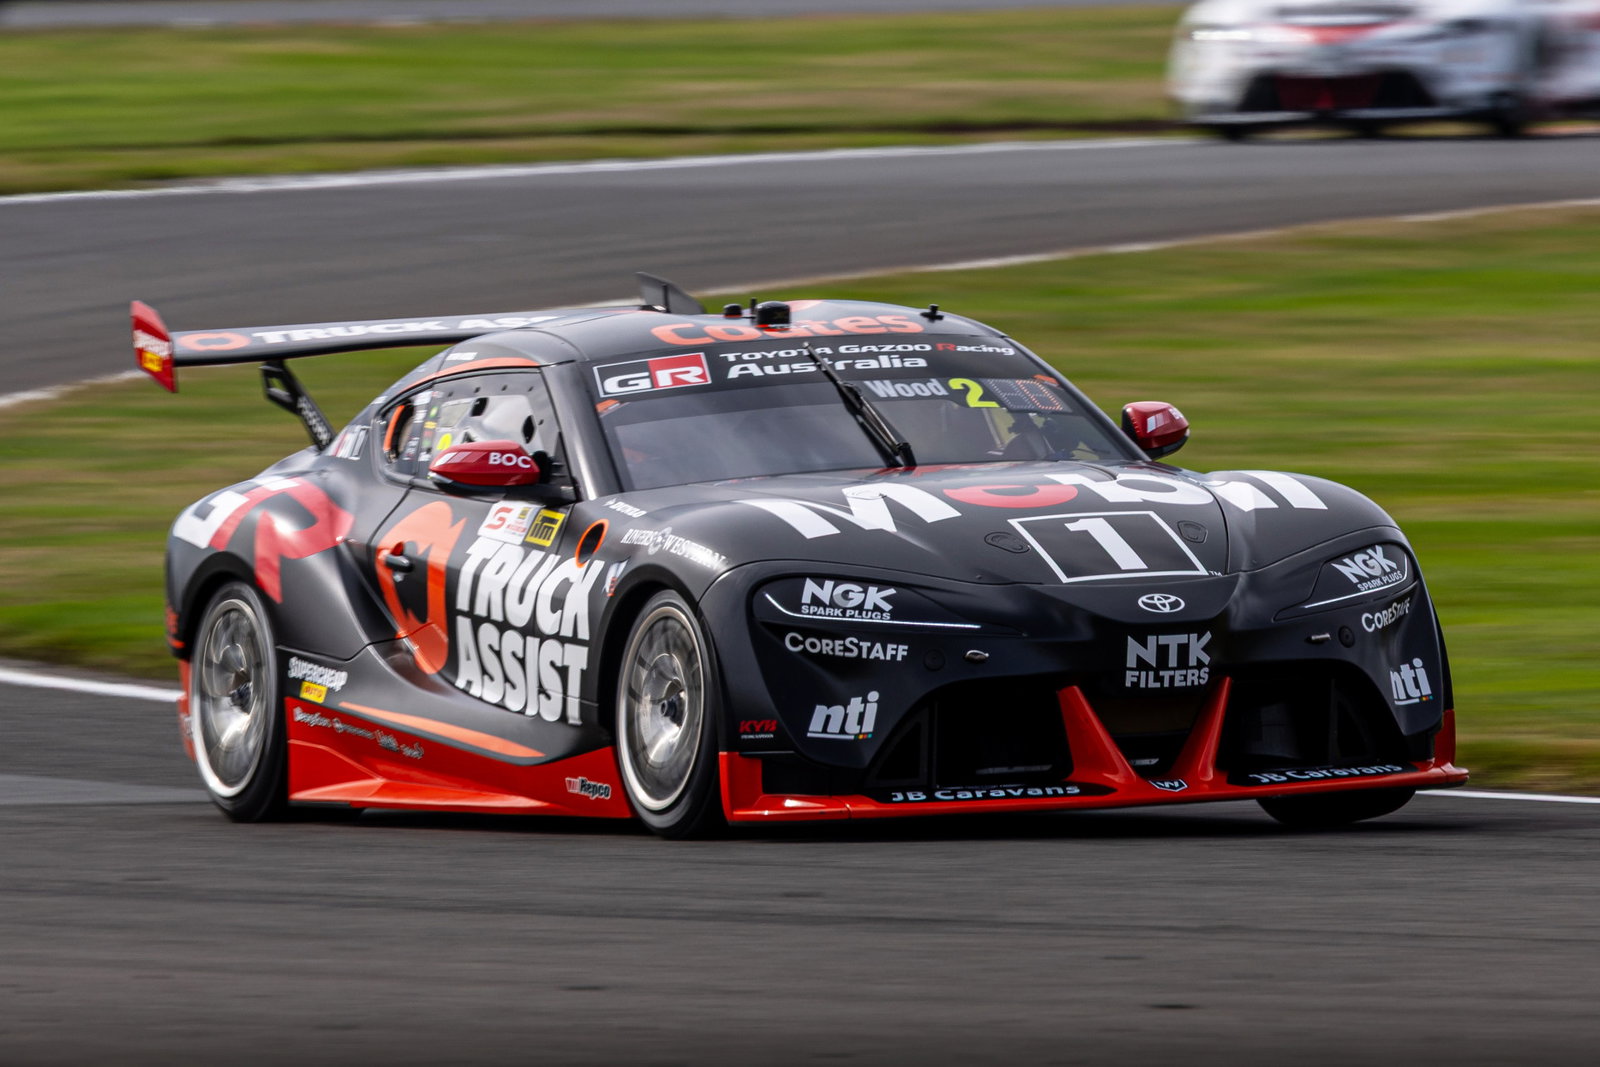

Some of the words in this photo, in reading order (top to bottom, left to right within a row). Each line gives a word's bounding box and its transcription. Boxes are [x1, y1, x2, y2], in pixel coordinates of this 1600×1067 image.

[251, 322, 448, 344] TRUCK
[651, 315, 924, 346] Coates
[720, 346, 834, 362] TOYOTA
[838, 344, 932, 355] GAZOO
[936, 343, 1015, 356] Racing
[727, 355, 928, 379] Australia
[603, 364, 706, 394] GR
[864, 378, 949, 398] Wood
[948, 378, 1000, 408] 2
[488, 452, 532, 469] BOC
[735, 470, 1329, 540] Mobil
[1064, 518, 1149, 570] 1
[1331, 544, 1398, 584] NGK
[455, 536, 605, 640] TRUCK
[801, 577, 897, 613] NGK
[1357, 578, 1382, 592] SPARK
[1382, 570, 1403, 585] PLUGS
[801, 604, 843, 617] SPARK
[845, 609, 892, 621] PLUGS
[1126, 630, 1212, 668] NTK
[454, 615, 590, 726] ASSIST
[1125, 667, 1209, 688] FILTERS
[1390, 657, 1432, 700] nti
[738, 719, 778, 733] KYB
[808, 691, 880, 734] nti
[579, 778, 611, 799] Repco
[1249, 772, 1288, 783] JB
[1286, 764, 1403, 779] Caravans
[892, 791, 926, 801] JB
[934, 785, 1080, 800] Caravans
